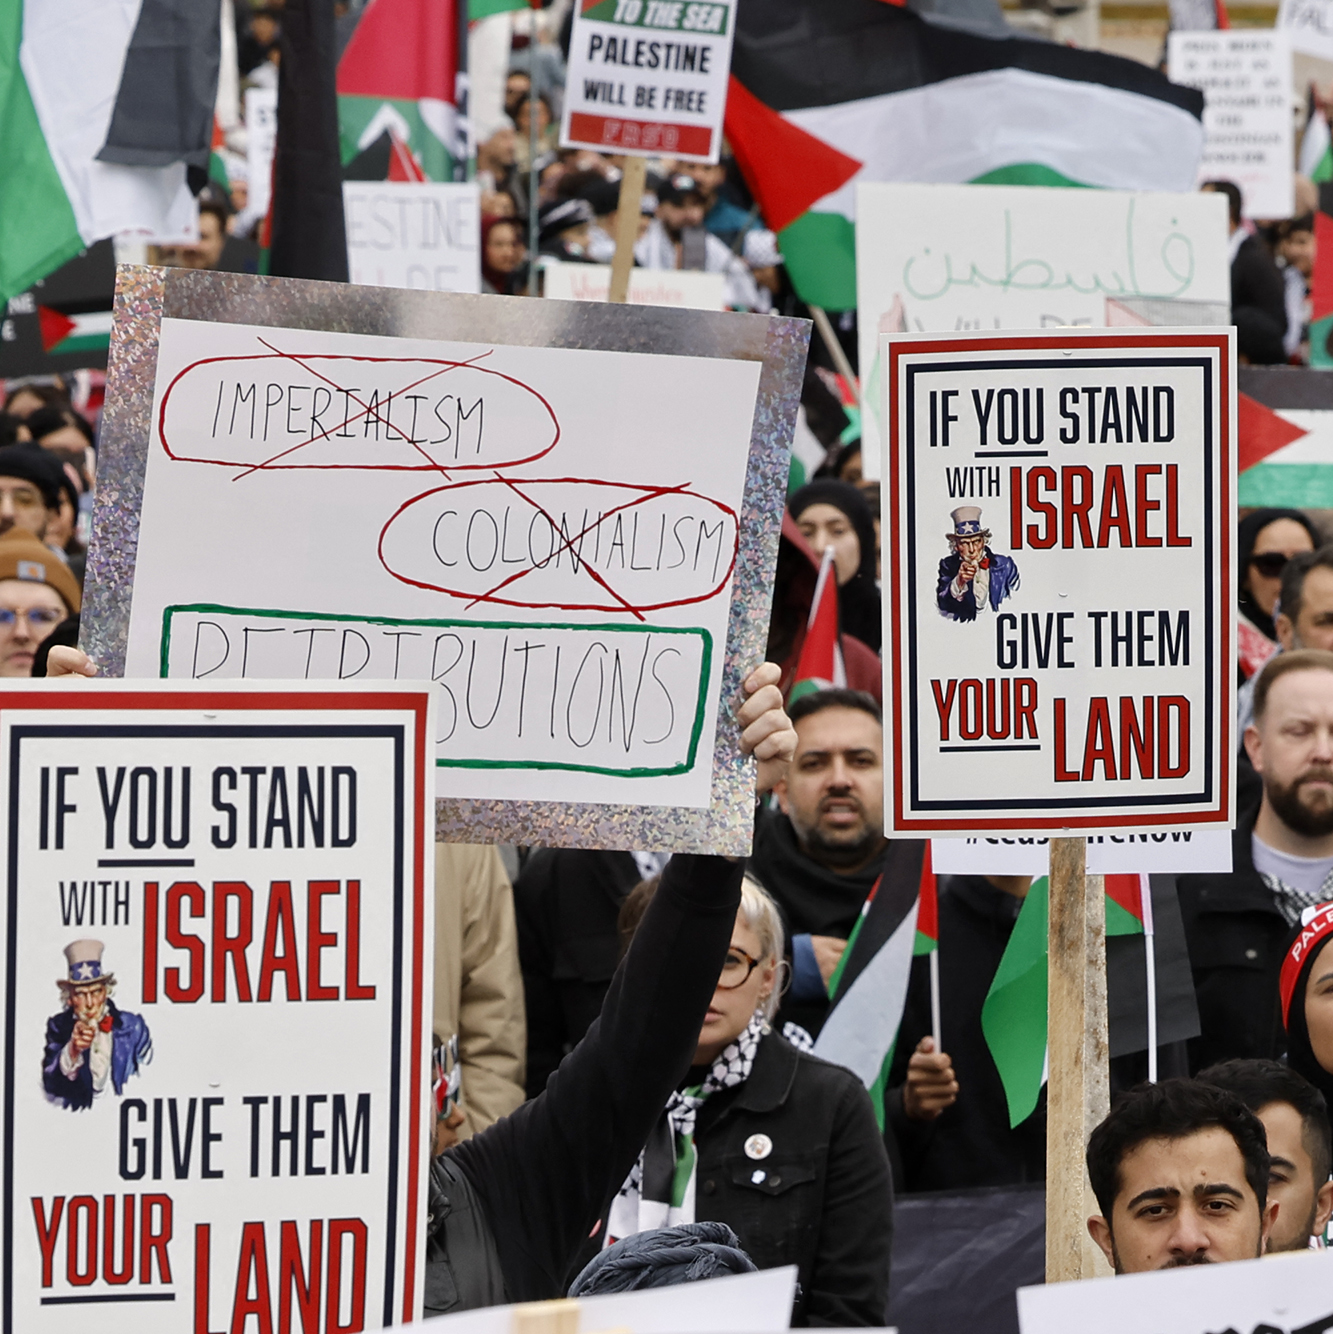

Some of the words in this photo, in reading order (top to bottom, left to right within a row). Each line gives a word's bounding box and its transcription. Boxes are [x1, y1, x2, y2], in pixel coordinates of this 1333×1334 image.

[588, 34, 712, 73] PALESTINE
[614, 0, 643, 23] TO
[644, 0, 684, 29] THE
[683, 3, 725, 32] SEA
[584, 78, 625, 106] WILL
[635, 85, 657, 109] BE
[664, 87, 706, 113] FREE
[346, 193, 477, 252] ESTINE
[212, 380, 485, 460] IMPERIALISM
[929, 390, 958, 448] IF
[974, 387, 1044, 446] YOU
[1058, 385, 1175, 444] STAND
[432, 507, 725, 584] COLONIALISM
[945, 466, 1001, 499] WITH
[1009, 462, 1192, 551] ISRAEL
[995, 611, 1075, 670] GIVE
[1086, 609, 1190, 669] THEM
[931, 677, 1039, 742] YOUR
[1053, 695, 1191, 783] LAND
[39, 767, 78, 850] IF
[97, 766, 192, 850] YOU
[210, 765, 358, 849] STAND
[59, 880, 130, 927] WITH
[140, 878, 377, 1005] ISRAEL
[118, 1095, 224, 1181] GIVE
[242, 1093, 371, 1177] THEM
[31, 1193, 174, 1288] YOUR
